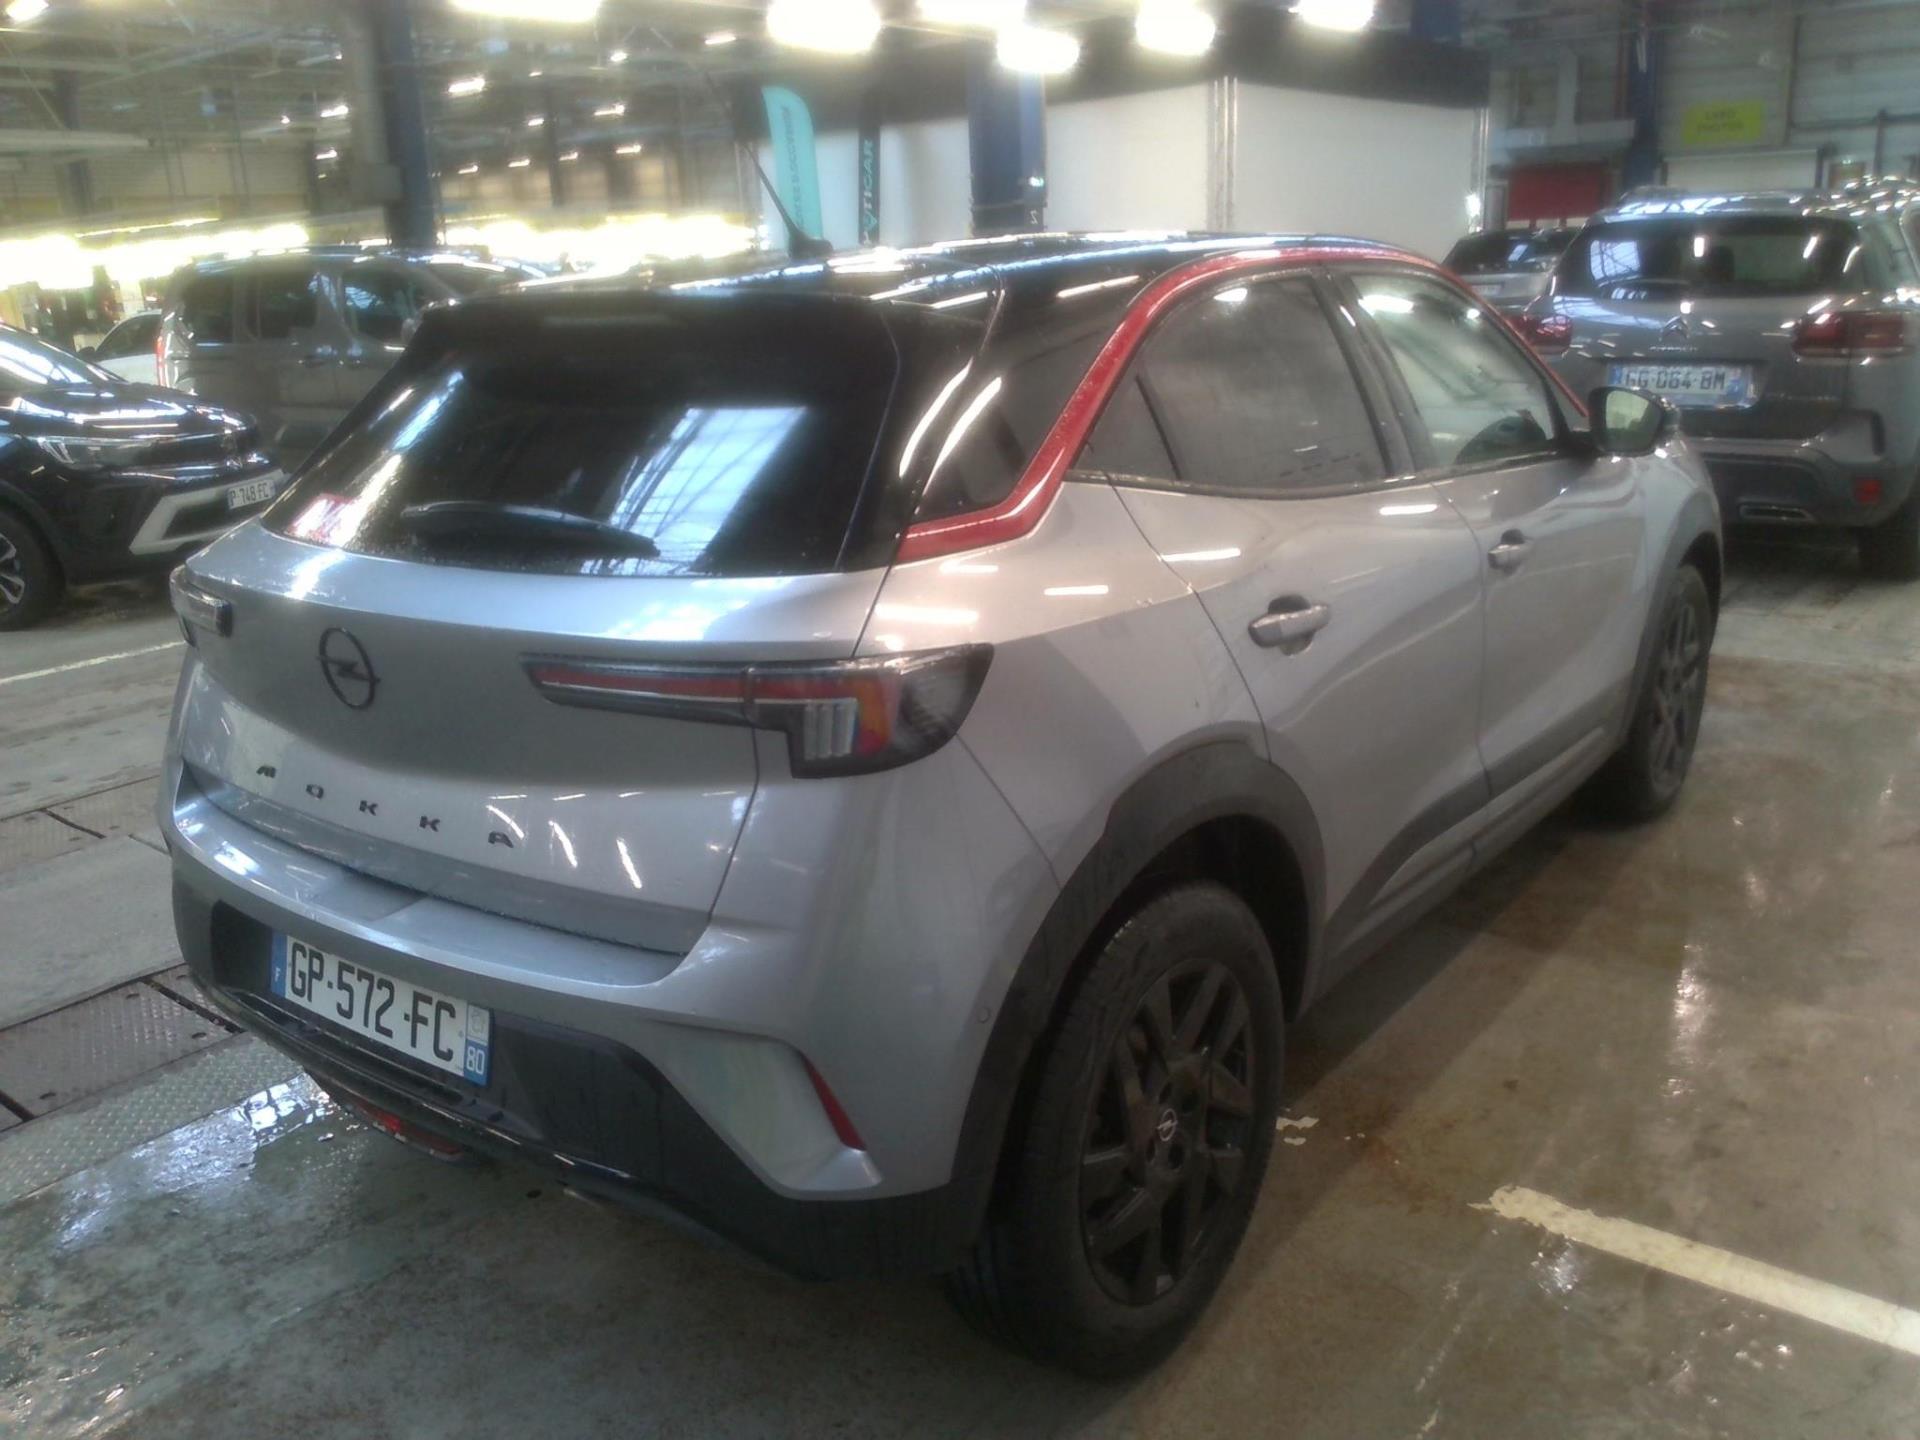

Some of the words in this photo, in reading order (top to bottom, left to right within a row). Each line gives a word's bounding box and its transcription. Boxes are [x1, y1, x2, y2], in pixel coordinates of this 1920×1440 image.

[256, 764, 514, 849] MOKKA
[290, 941, 457, 1062] GP-572-FC
[466, 1045, 486, 1076] 80
